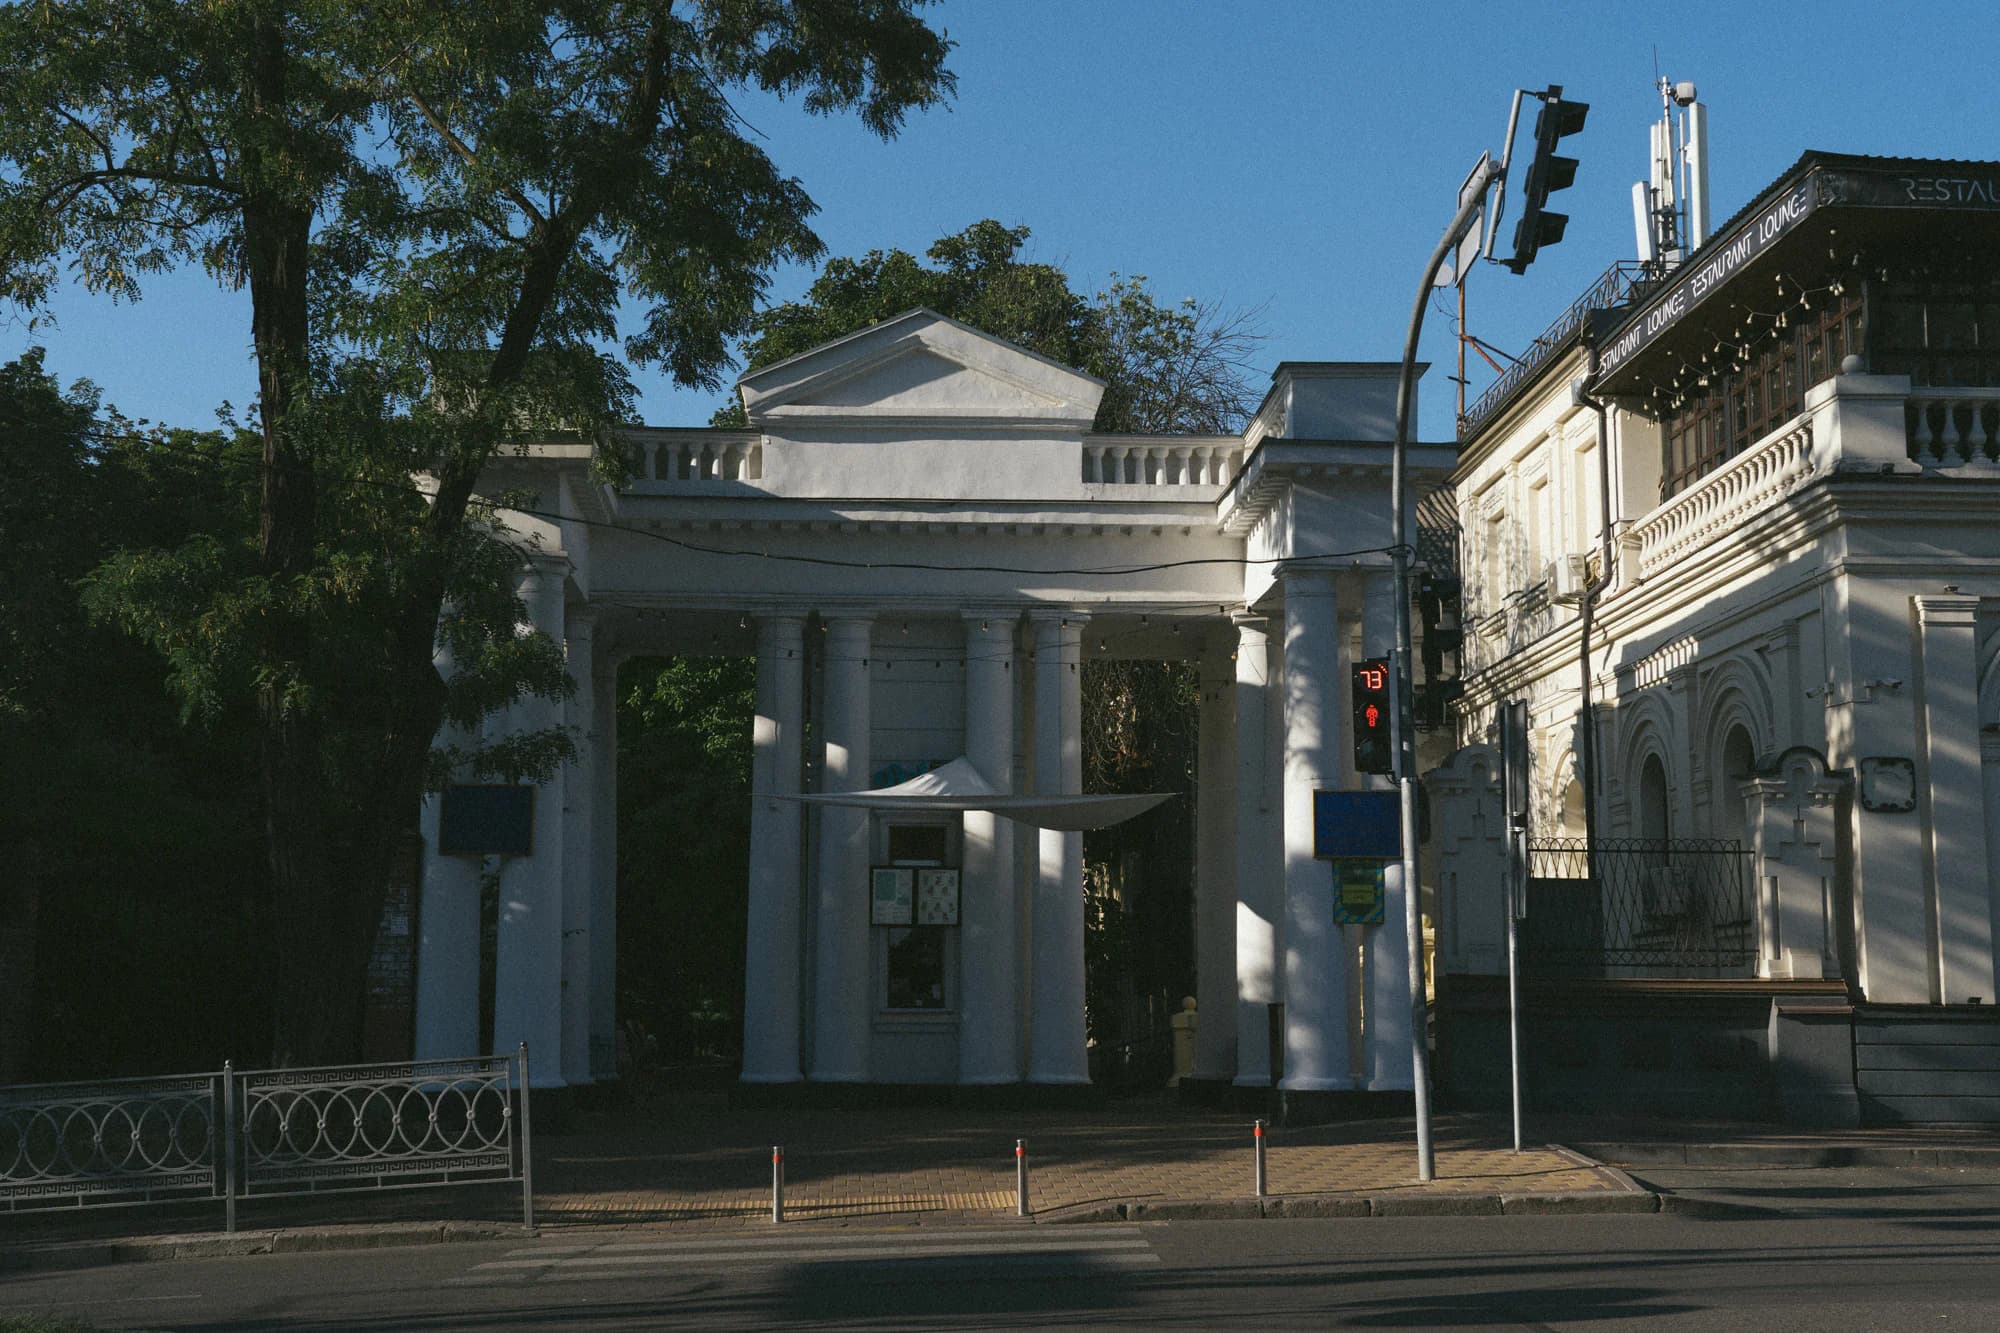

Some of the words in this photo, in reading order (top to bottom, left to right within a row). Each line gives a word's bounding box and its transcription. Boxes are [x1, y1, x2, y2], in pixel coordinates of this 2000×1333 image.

[1598, 325, 1642, 377] STAURANT
[1646, 288, 1684, 336] LOUNGE
[1690, 231, 1753, 298] RESTAURANT
[1759, 187, 1807, 244] LOUNGE
[1360, 670, 1382, 689] 73
